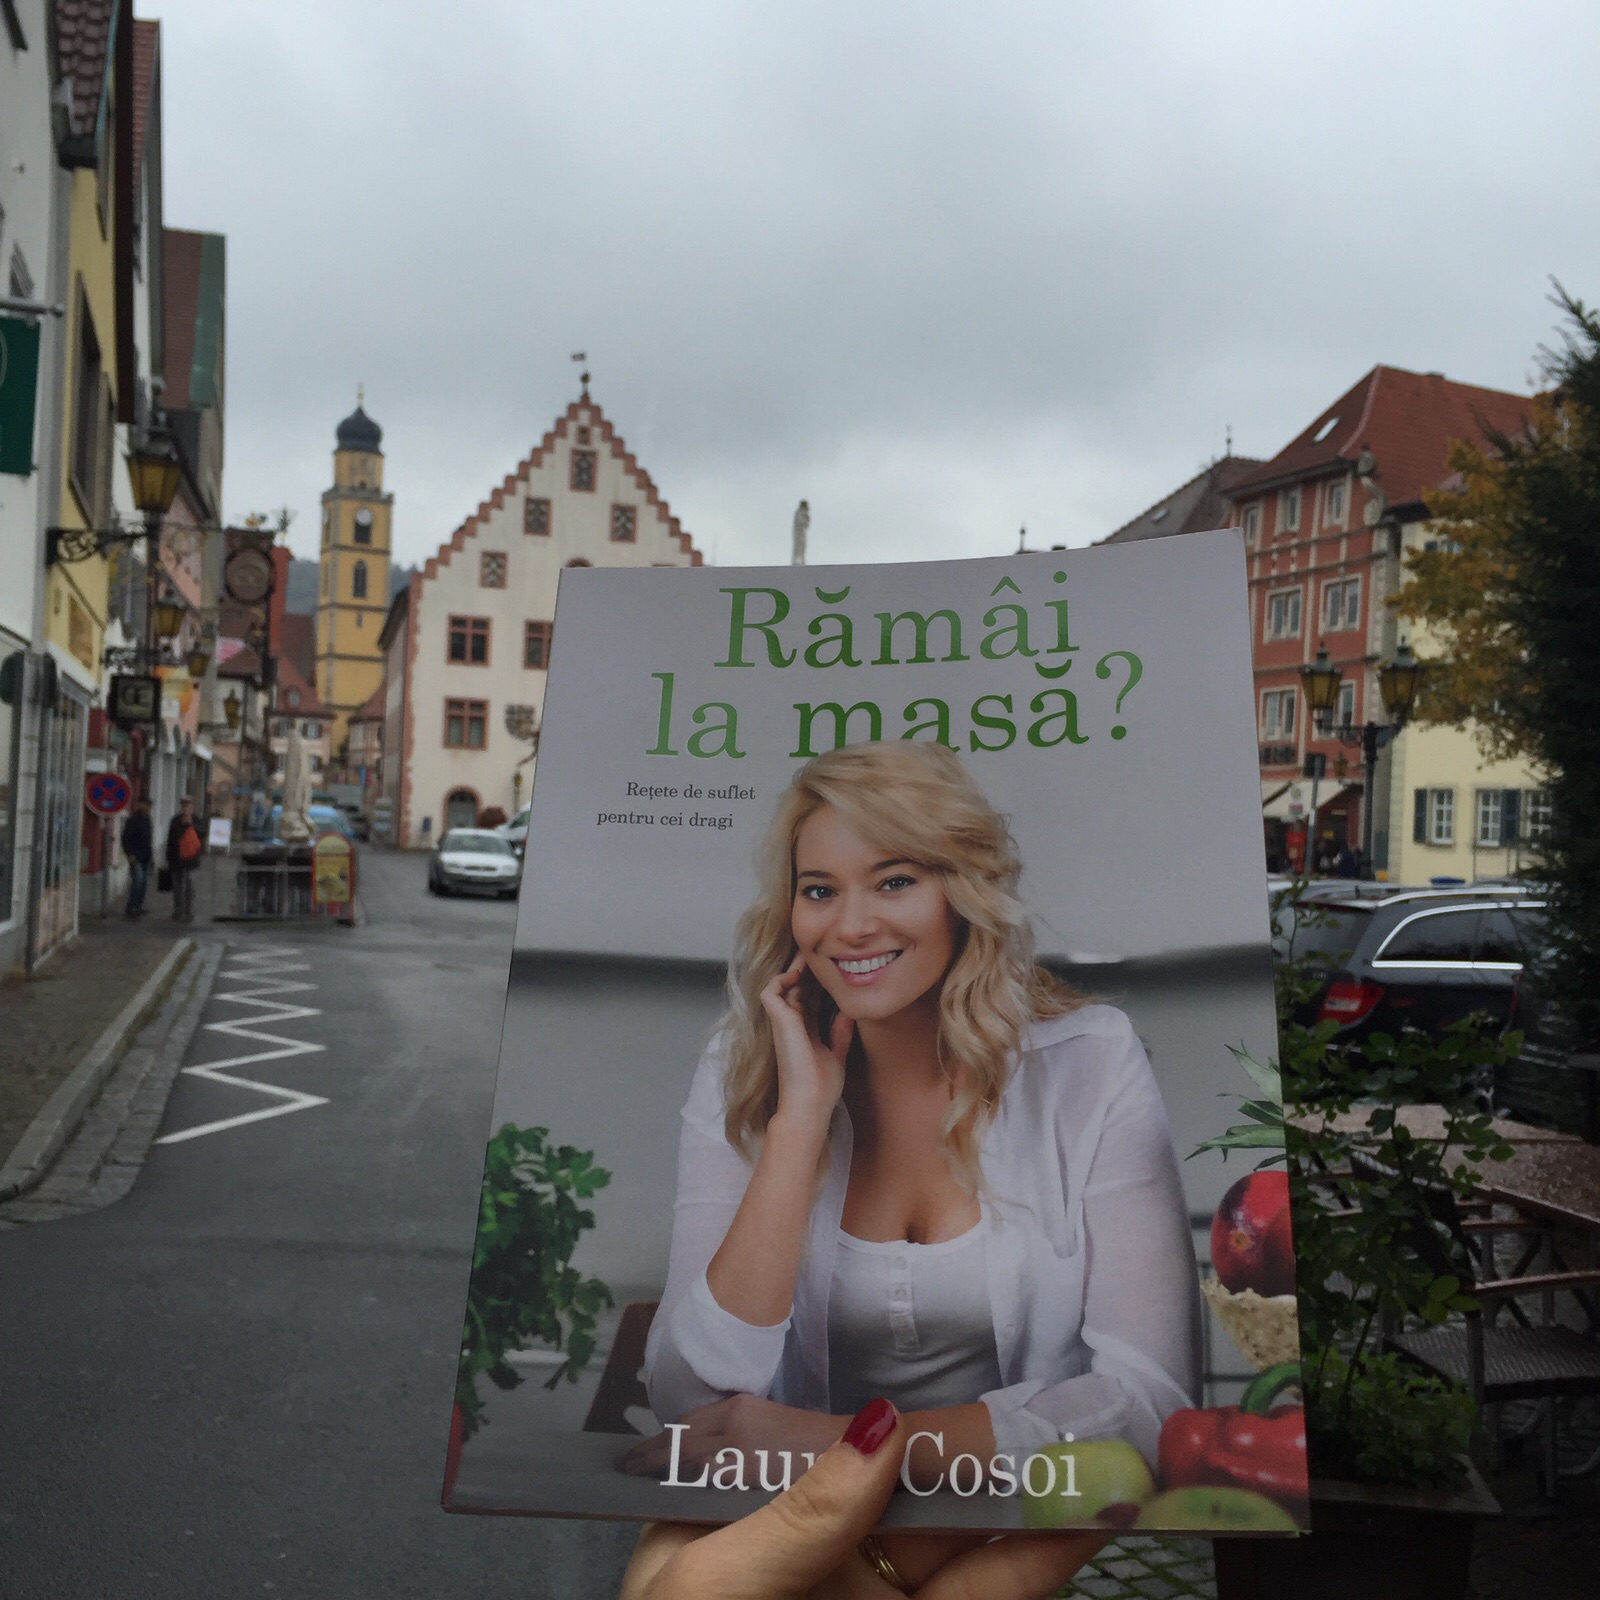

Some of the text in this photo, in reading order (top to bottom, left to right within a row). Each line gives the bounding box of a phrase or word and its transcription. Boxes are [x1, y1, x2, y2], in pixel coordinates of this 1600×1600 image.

[713, 570, 1080, 669] Rămâi
[645, 650, 1144, 759] la masă?
[596, 811, 733, 831] pentru cei dragi
[683, 784, 703, 799] de
[707, 785, 756, 800] suflet
[660, 1423, 1082, 1498] Lau Cosoi
